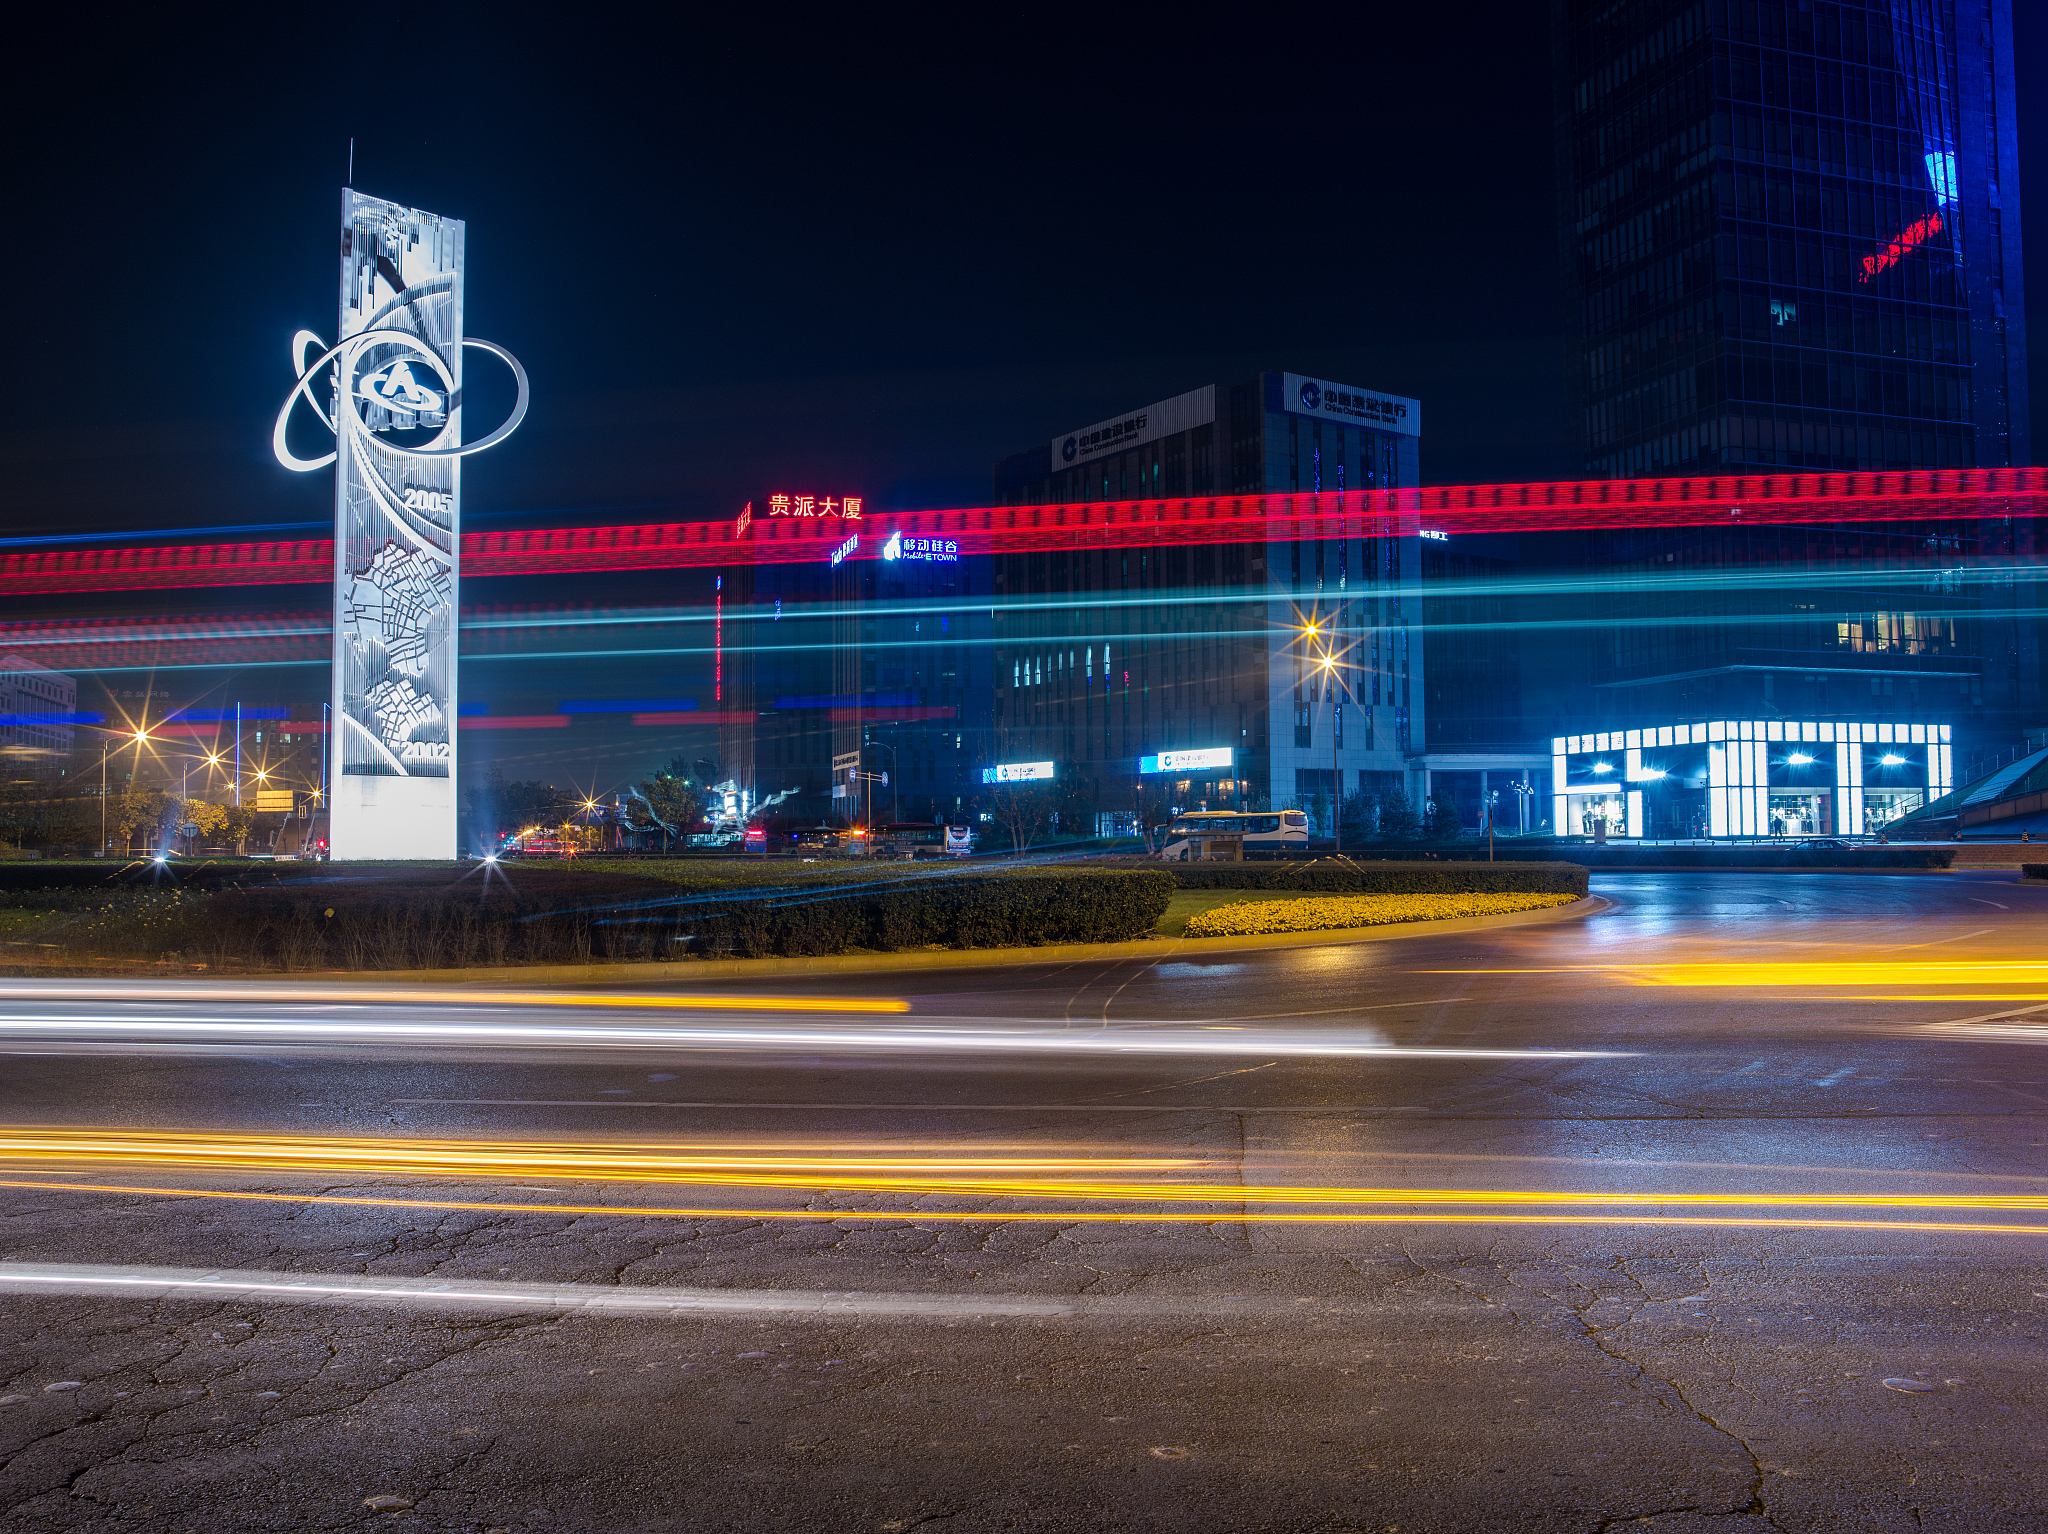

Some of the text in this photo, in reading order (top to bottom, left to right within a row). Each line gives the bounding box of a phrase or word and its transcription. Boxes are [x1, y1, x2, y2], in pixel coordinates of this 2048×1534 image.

[404, 488, 453, 513] 2005
[769, 493, 863, 520] 贵派大厦
[903, 538, 957, 553] 移动硅谷
[401, 741, 450, 759] 2002
